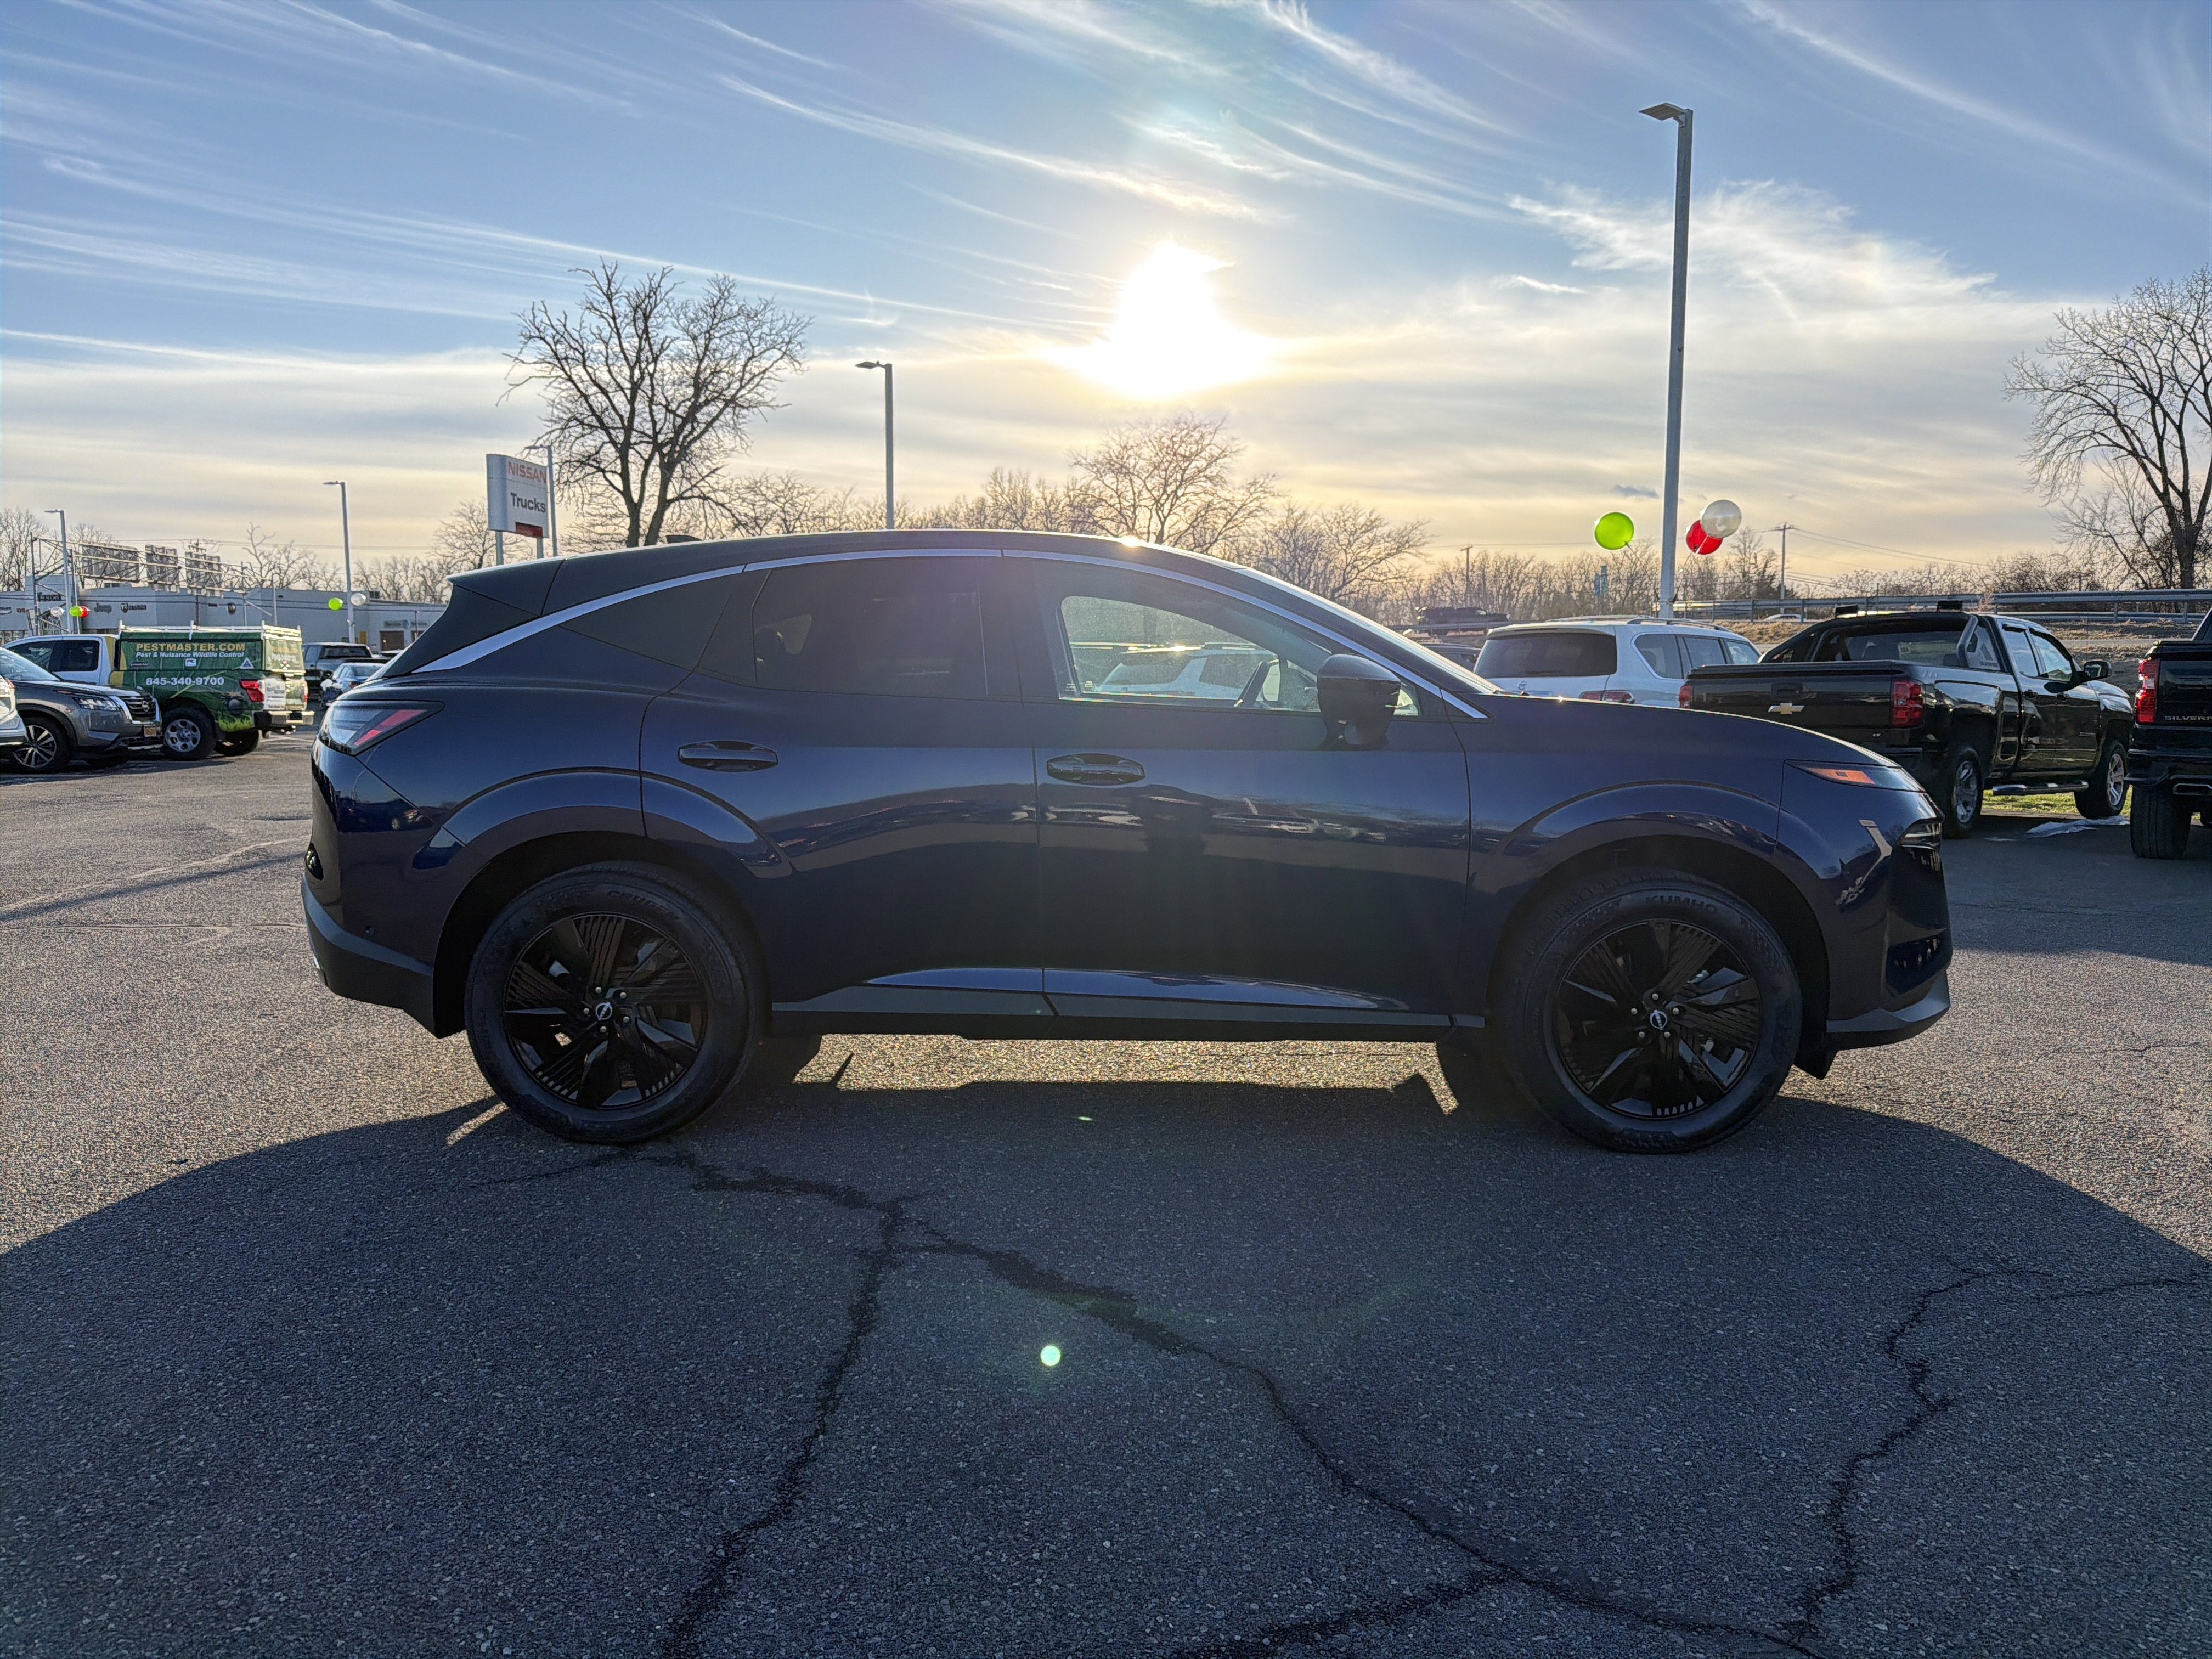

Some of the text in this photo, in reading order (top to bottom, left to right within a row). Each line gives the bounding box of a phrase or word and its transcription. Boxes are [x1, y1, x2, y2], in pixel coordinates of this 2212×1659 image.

[508, 461, 547, 484] NISSAN
[510, 492, 546, 513] Trucks
[136, 643, 245, 651] PESTMASTER.COM
[146, 677, 224, 686] 845-340-9700
